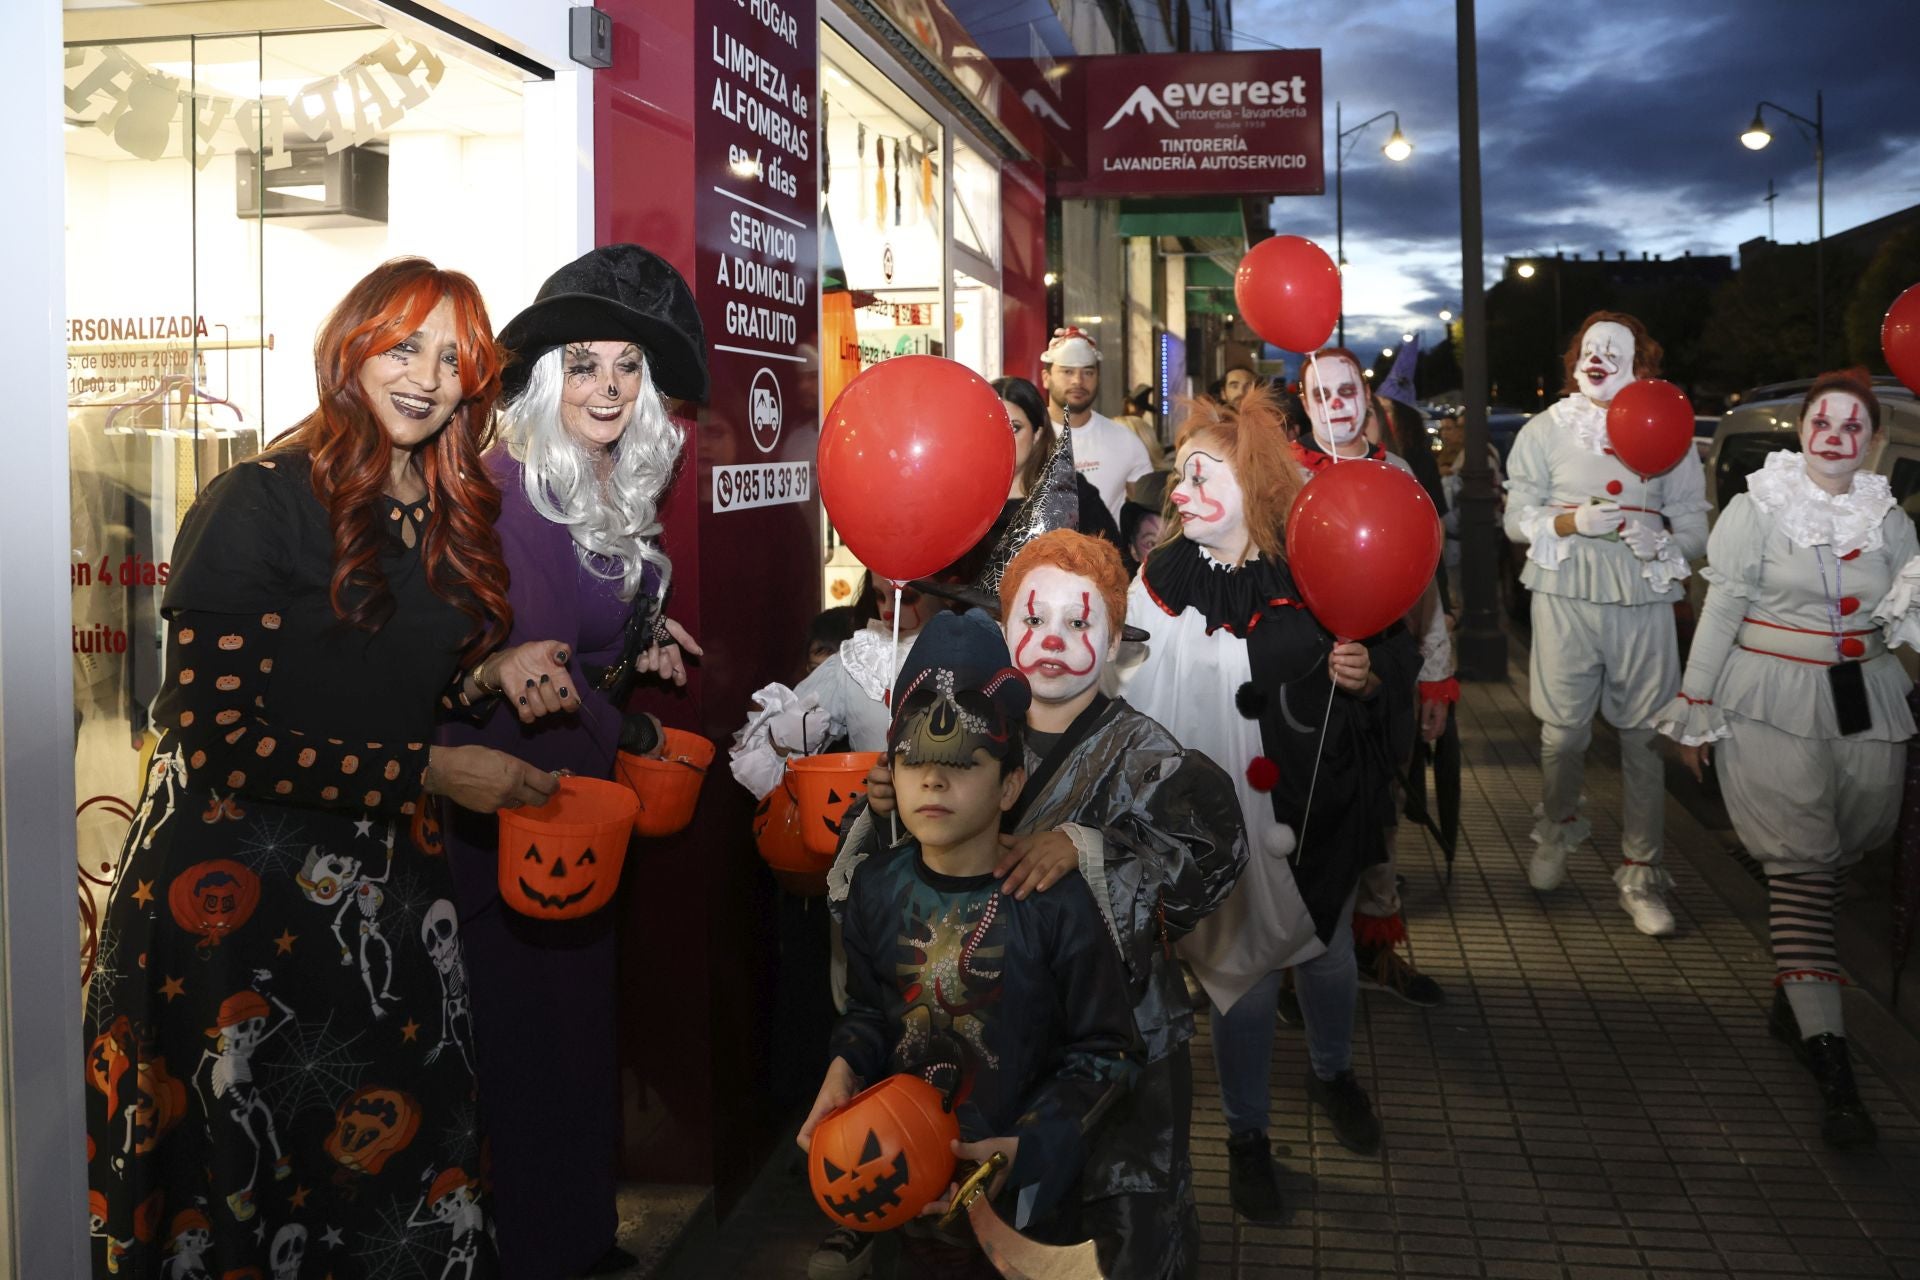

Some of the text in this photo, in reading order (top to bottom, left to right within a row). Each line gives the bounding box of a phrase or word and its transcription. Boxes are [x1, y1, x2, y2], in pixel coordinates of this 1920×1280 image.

[712, 25, 808, 119] LIMPIEZA de
[1162, 76, 1307, 107] everest
[711, 77, 809, 162] ALFOMBRAS
[1103, 153, 1307, 171] LAVANDERÍA AUTOSERVICIO
[1160, 134, 1248, 153] TINTORERÍA
[755, 148, 764, 183] 4
[768, 156, 797, 198] días
[730, 210, 796, 264] SERVICIO
[717, 253, 806, 307] A DOMICILIO
[725, 301, 797, 345] GRATUITO
[81, 353, 97, 369] de
[101, 352, 137, 368] 09:00
[141, 355, 148, 367] a
[734, 466, 808, 503] 985 13 39 39
[98, 555, 113, 586] 4
[119, 553, 170, 586] días
